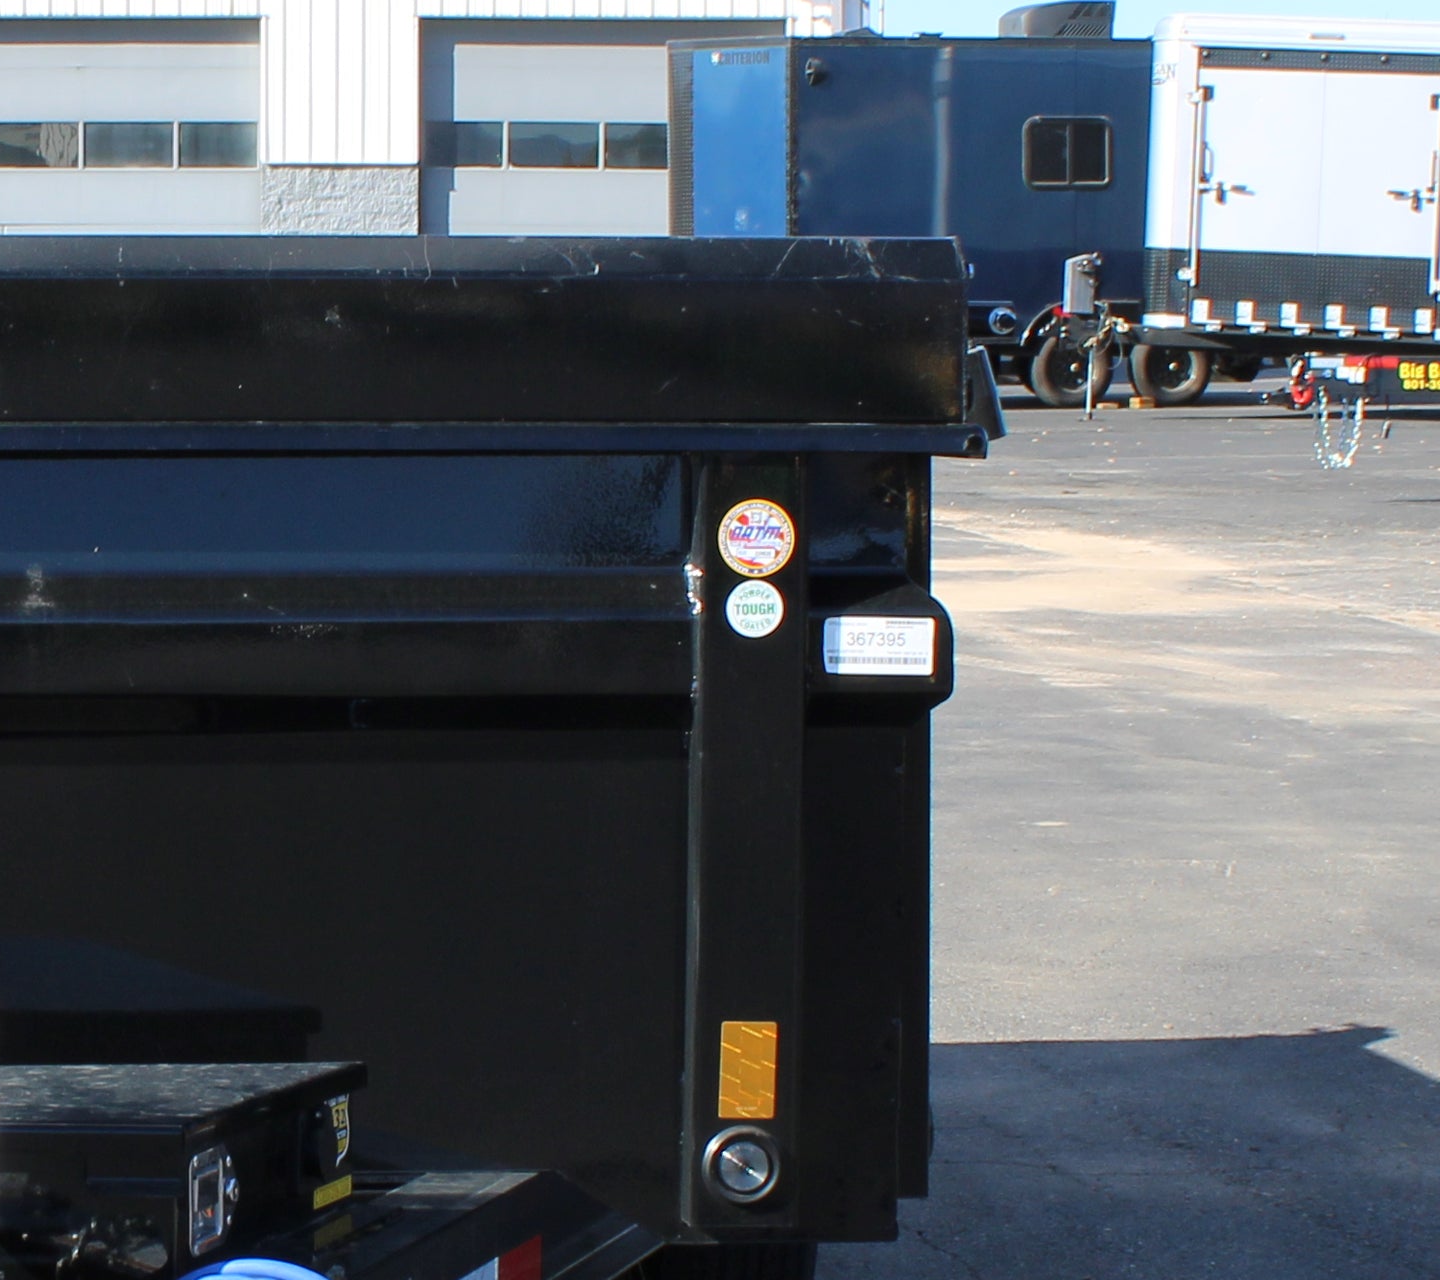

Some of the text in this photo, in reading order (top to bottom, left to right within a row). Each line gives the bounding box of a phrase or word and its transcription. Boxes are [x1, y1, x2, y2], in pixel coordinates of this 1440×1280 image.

[1398, 361, 1426, 380] Big
[734, 602, 776, 616] TOUGH
[846, 631, 906, 647] 367395
